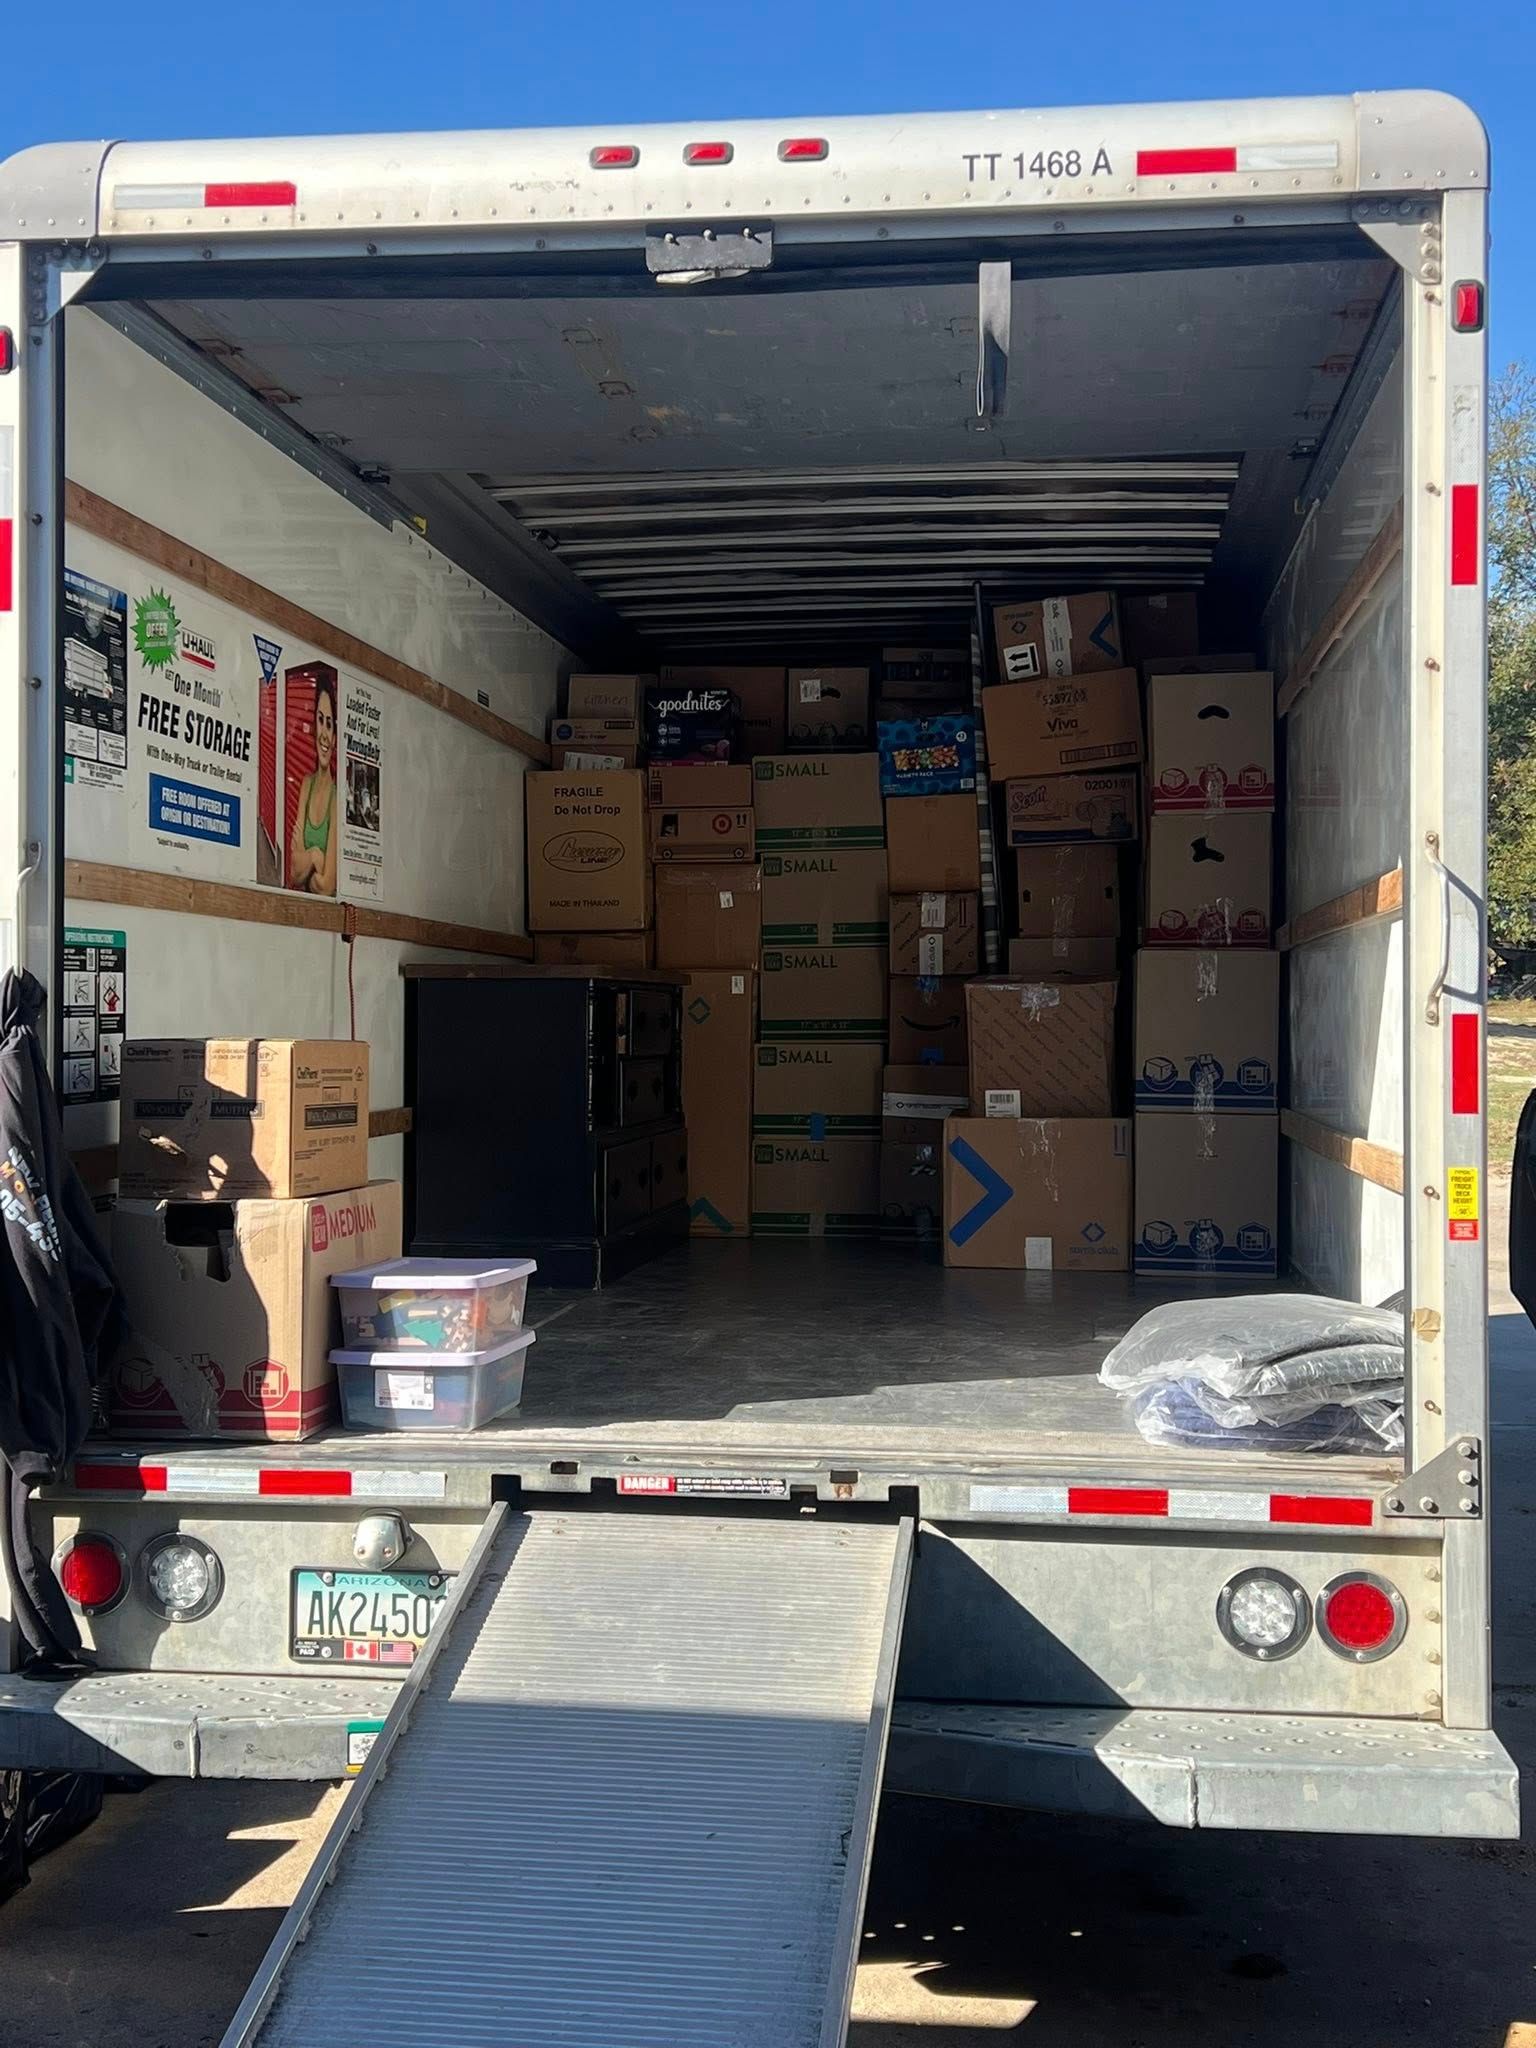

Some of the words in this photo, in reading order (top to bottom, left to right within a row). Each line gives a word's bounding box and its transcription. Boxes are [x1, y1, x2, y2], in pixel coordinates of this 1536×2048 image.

[962, 154, 1002, 181] TT
[1013, 150, 1081, 180] 1468
[1091, 148, 1113, 177] A
[181, 631, 216, 660] U-HAUL
[174, 673, 191, 697] One
[654, 690, 725, 718] goodnites
[138, 693, 181, 739] FREE
[184, 709, 252, 762] STORAGE
[1046, 718, 1078, 732] Viva
[161, 748, 186, 769] One-Way
[187, 757, 201, 771] Truck
[776, 763, 829, 778] SMALL
[555, 786, 604, 798] FRAGILE
[162, 787, 178, 804] FREE
[197, 796, 222, 815] OFFERED
[555, 805, 569, 815] Do
[573, 805, 591, 815] Not
[595, 804, 621, 816] Drop
[784, 859, 838, 873] SMALL
[550, 899, 571, 908] MADE
[583, 899, 620, 908] THAILAND
[784, 954, 838, 969] SMALL
[779, 1050, 832, 1064] SMALL
[775, 1148, 829, 1162] SMALL
[329, 1203, 377, 1241] MEDIUM
[623, 1477, 670, 1491] DANGER
[339, 1576, 426, 1589] ARIZONA
[308, 1591, 447, 1639] AK2450
